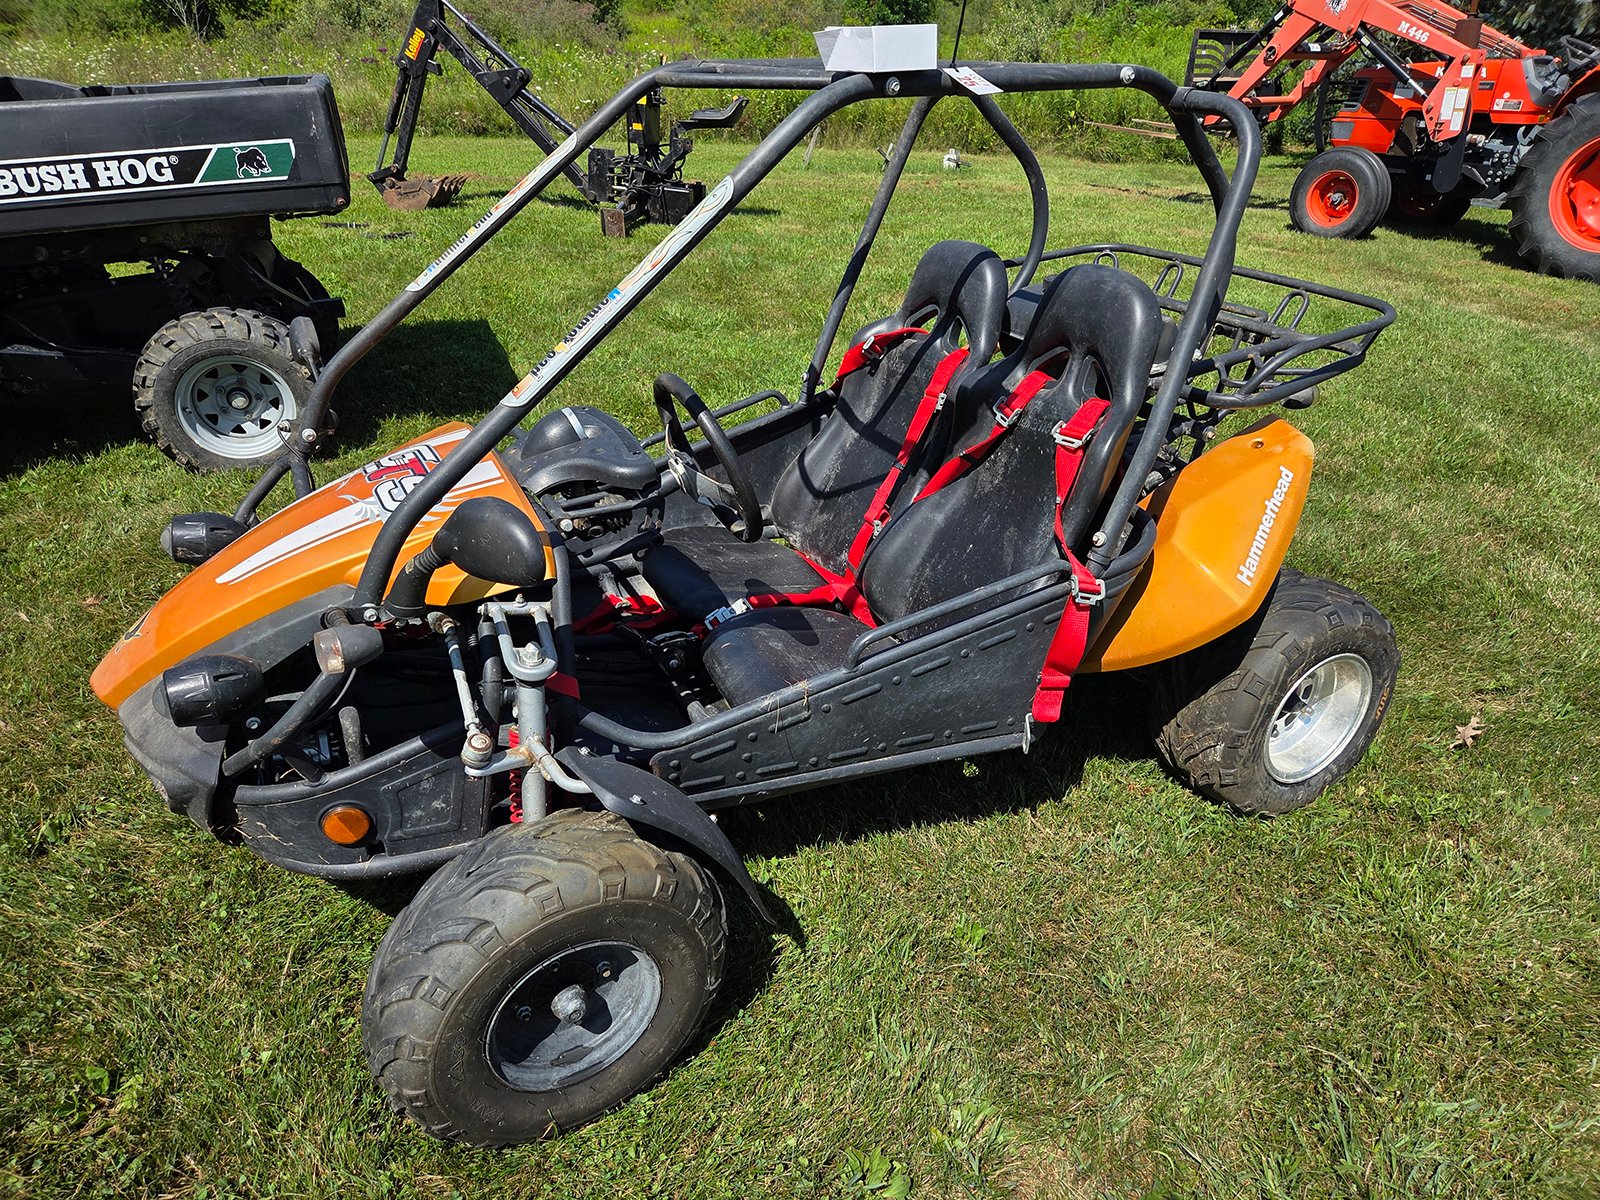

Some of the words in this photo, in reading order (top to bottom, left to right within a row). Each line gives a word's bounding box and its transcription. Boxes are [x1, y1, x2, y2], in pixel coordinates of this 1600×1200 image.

[404, 27, 426, 60] Kelley
[0, 163, 91, 197] BUSH
[1235, 464, 1295, 588] Hammerhead
